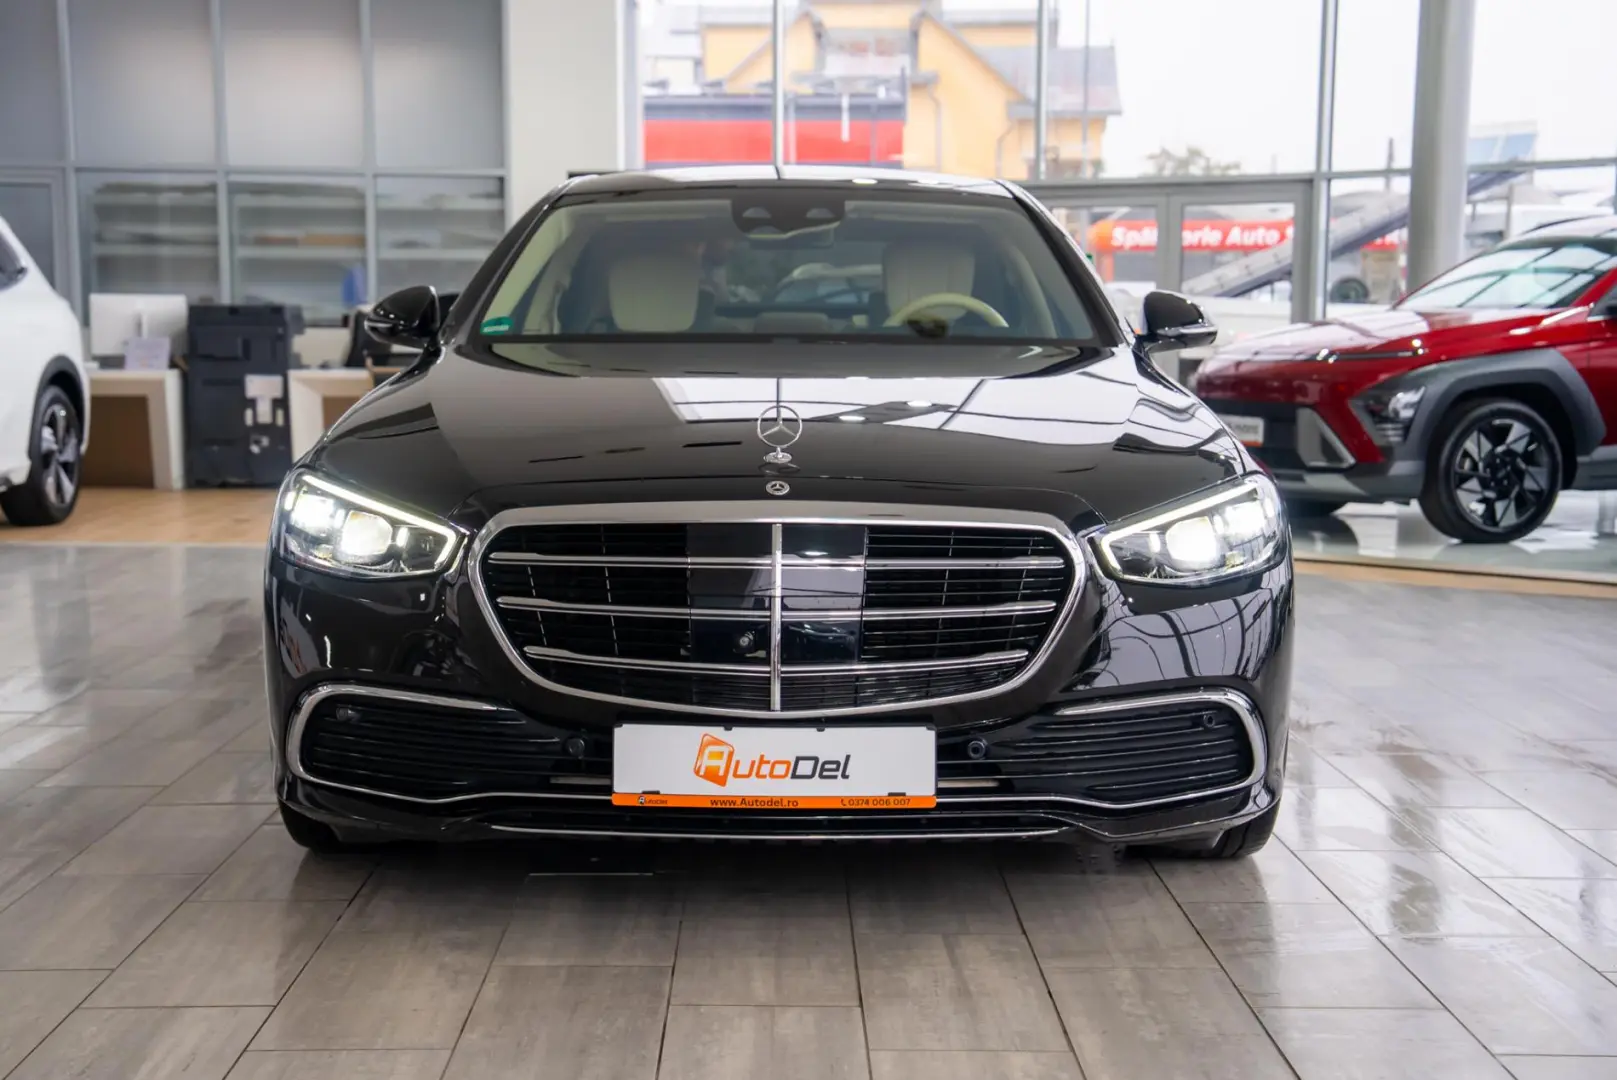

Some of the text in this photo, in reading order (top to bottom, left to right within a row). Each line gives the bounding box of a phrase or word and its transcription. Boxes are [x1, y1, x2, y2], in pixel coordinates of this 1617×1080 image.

[1226, 225, 1280, 247] Auto
[697, 738, 851, 784] AutoDel
[710, 798, 799, 808] www.Autodel.ro
[848, 798, 911, 806] 0374 006 007
